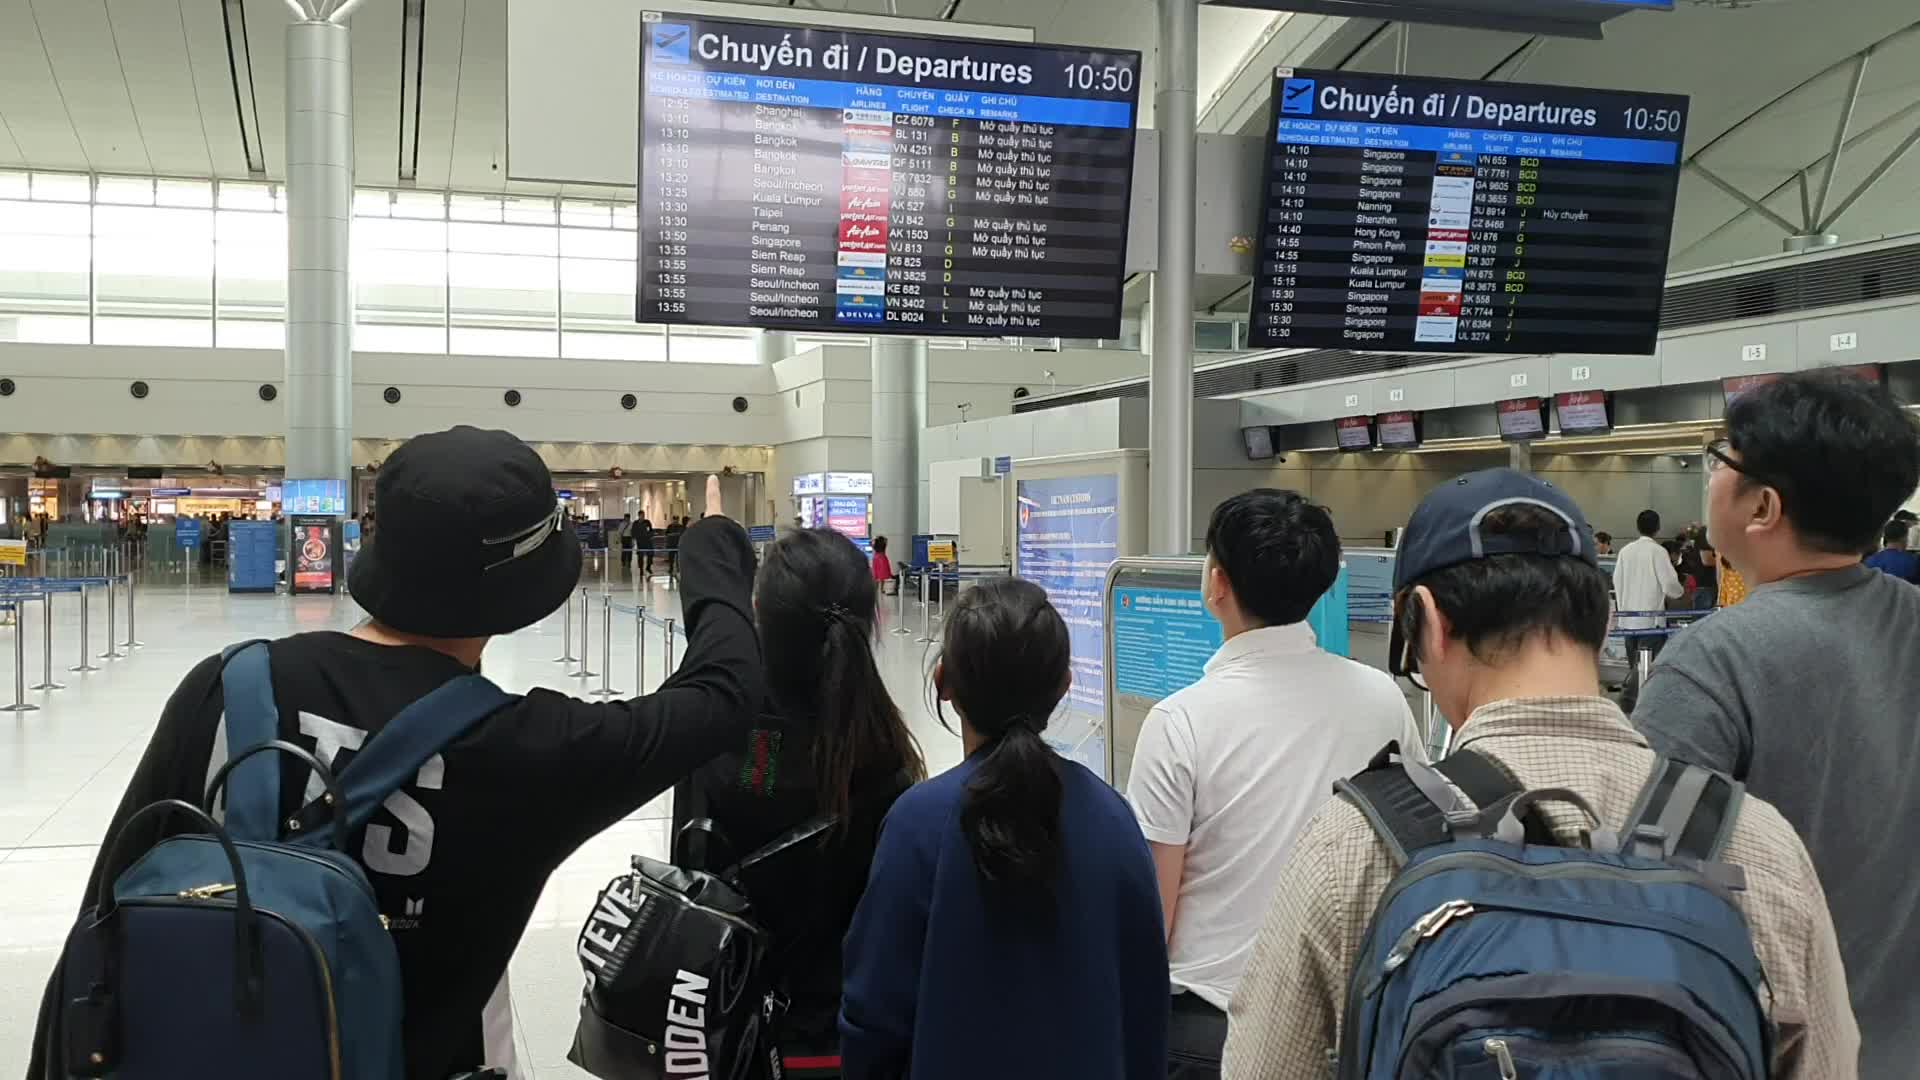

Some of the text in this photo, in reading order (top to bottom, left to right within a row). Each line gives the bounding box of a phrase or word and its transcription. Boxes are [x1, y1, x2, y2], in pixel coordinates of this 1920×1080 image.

[697, 33, 1033, 85] Chuyến đi / Departures
[1064, 63, 1133, 92] 10:50
[756, 93, 809, 104] DESTINATION
[981, 96, 1017, 106] GHI CHÚ
[850, 100, 887, 110] AIRLINES
[901, 103, 929, 113] FLIGHT
[1320, 85, 1597, 126] Chuyến đi / Departures
[755, 104, 802, 120] Shanghai
[938, 106, 975, 116] CHECK IN
[980, 109, 1018, 119] REMARKS
[895, 114, 909, 125] CZ
[911, 116, 935, 127] 6078
[952, 118, 960, 129] F
[1623, 107, 1681, 132] 10:50
[979, 120, 996, 131] Mở
[1022, 122, 1038, 134] thủ
[1039, 124, 1054, 136] tục
[895, 129, 909, 140] BL
[910, 130, 929, 141] 131
[951, 133, 959, 143] B
[979, 134, 995, 145] Mở
[1021, 136, 1037, 148] thủ
[1038, 138, 1053, 150] tục
[893, 143, 934, 155] VN 4251
[951, 147, 958, 157] B
[1286, 145, 1310, 156] 14:10
[1363, 149, 1406, 162] Singapore
[909, 158, 933, 170] 5111
[1284, 159, 1309, 169] 14:10
[1520, 157, 1540, 166] BCD
[1361, 162, 1404, 175] Singapore
[660, 172, 688, 184] 13:20
[660, 187, 688, 199] 13:25
[660, 202, 687, 213] 13:30
[891, 200, 925, 211] AK 527
[1280, 199, 1305, 209] 14:10
[1357, 202, 1392, 214] Nanning
[752, 207, 783, 220] Taipei
[659, 216, 687, 227] 13:30
[892, 214, 924, 225] VJ 842
[946, 217, 955, 227] G
[1356, 215, 1398, 226] Shenzhen
[752, 221, 790, 234] Penang
[1277, 225, 1302, 235] 14:40
[659, 231, 687, 242] 13:50
[889, 228, 929, 240] AK 1503
[1354, 228, 1401, 240] Hong Kong
[751, 235, 801, 249] Singapore
[890, 242, 903, 252] VJ
[905, 243, 923, 253] 813
[1276, 238, 1300, 248] 14:55
[1353, 241, 1407, 252] Phnom Penh
[659, 245, 686, 256] 13:55
[944, 245, 953, 255] G
[972, 246, 988, 256] Mở
[1014, 247, 1029, 258] thủ
[1030, 249, 1045, 260] tục
[751, 249, 806, 264] Siem Reap
[904, 257, 922, 267] 825
[658, 259, 686, 270] 13:55
[944, 259, 952, 268] D
[1273, 264, 1297, 274] 15:15
[751, 264, 805, 278] Siem Reap
[887, 270, 927, 281] VN 3825
[1350, 267, 1407, 278] Kuala Lumpur
[1506, 272, 1526, 280] BCD
[658, 274, 685, 285] 13:55
[751, 278, 820, 290] Seoul/Incheon
[658, 288, 685, 299] 13:55
[887, 284, 920, 294] KE 682
[943, 286, 950, 296] L
[1271, 290, 1295, 299] 15:30
[750, 292, 819, 304] Seoul/Incheon
[886, 297, 925, 308] VN 3402
[1347, 292, 1389, 303] Singapore
[657, 302, 685, 313] 13:55
[750, 306, 818, 318] Seoul/Incheon
[846, 311, 873, 319] DELTA
[886, 311, 924, 322] DL 9024
[942, 313, 949, 323] L
[968, 314, 984, 324] Mở
[1009, 315, 1025, 326] thủ
[1026, 317, 1041, 327] tục
[1267, 328, 1291, 337] 15:30
[1343, 329, 1385, 340] Singapore
